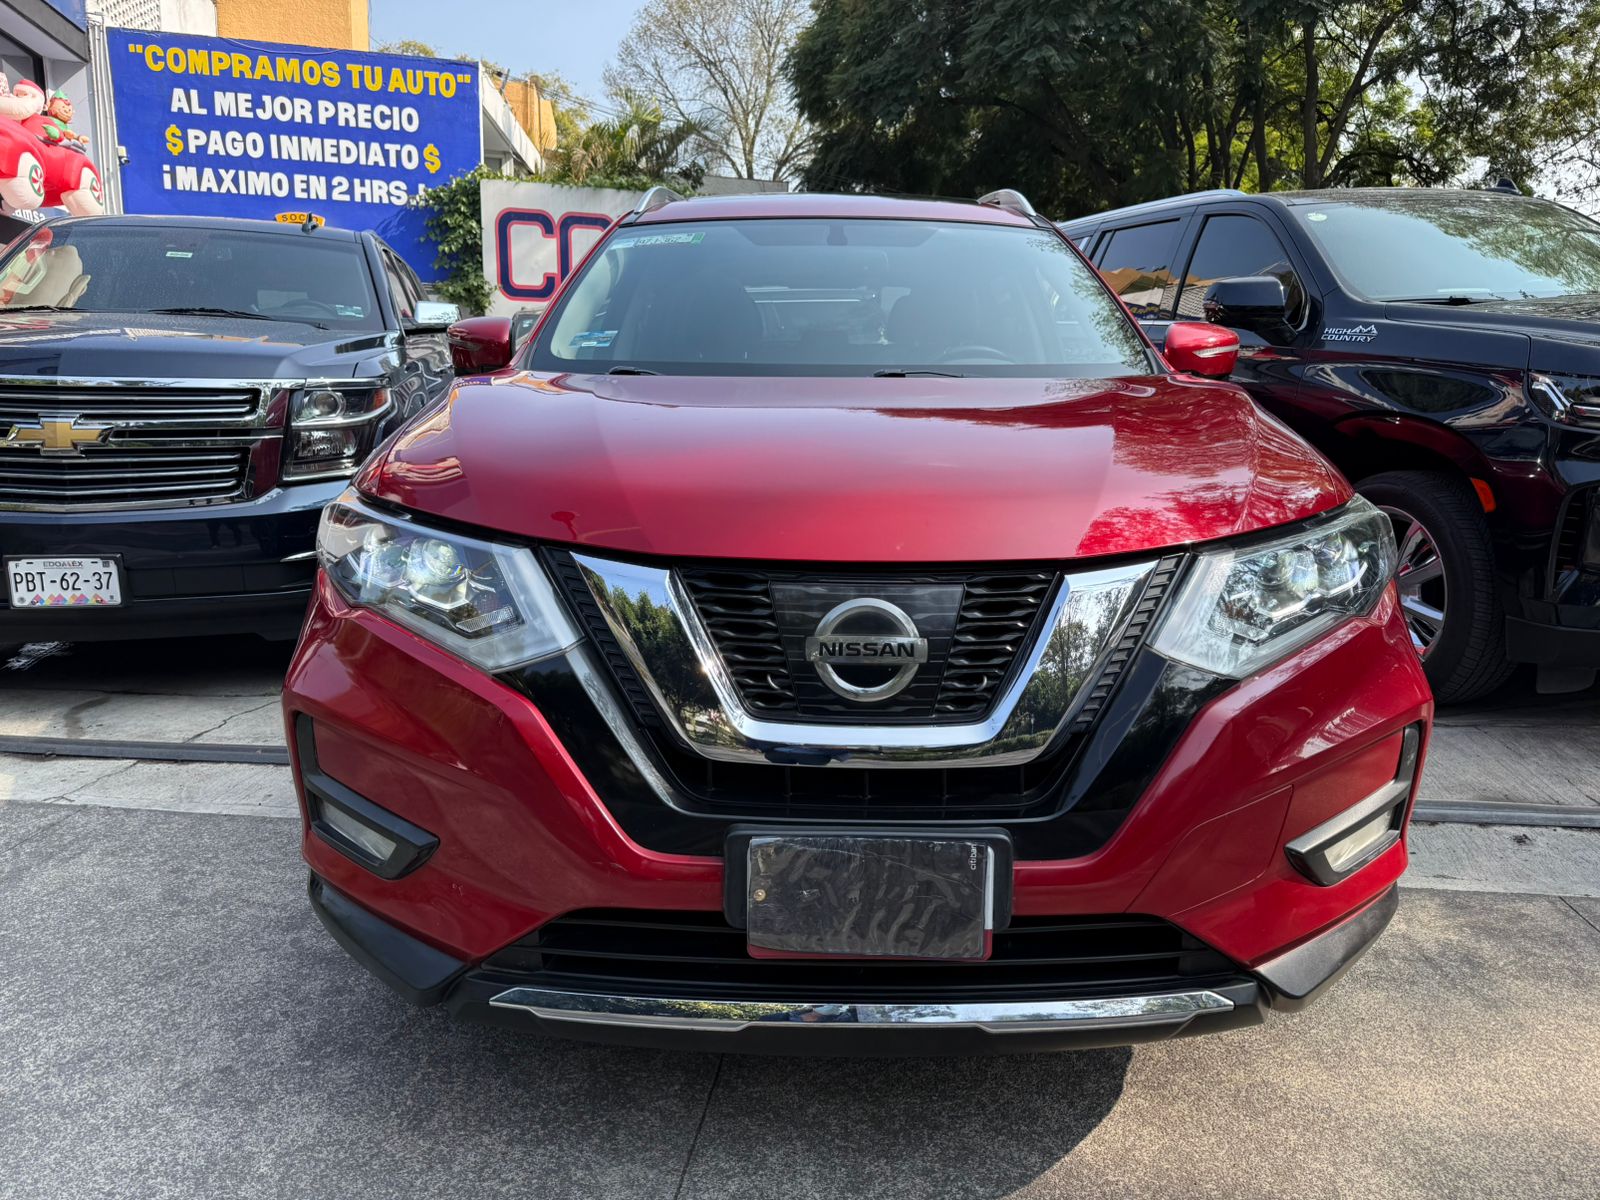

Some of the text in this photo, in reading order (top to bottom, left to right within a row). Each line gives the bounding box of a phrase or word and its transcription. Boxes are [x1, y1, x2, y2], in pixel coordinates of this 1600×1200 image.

[128, 44, 472, 99] "COMPRAMOS TU AUTO"
[170, 88, 420, 133] AL MEJOR PRECIO
[293, 173, 328, 200] EN
[331, 176, 351, 202] 2
[1321, 334, 1376, 342] COUNTRY
[1324, 327, 1352, 335] HIGH
[13, 571, 113, 593] PBT-62-37
[819, 641, 915, 657] NISSAN
